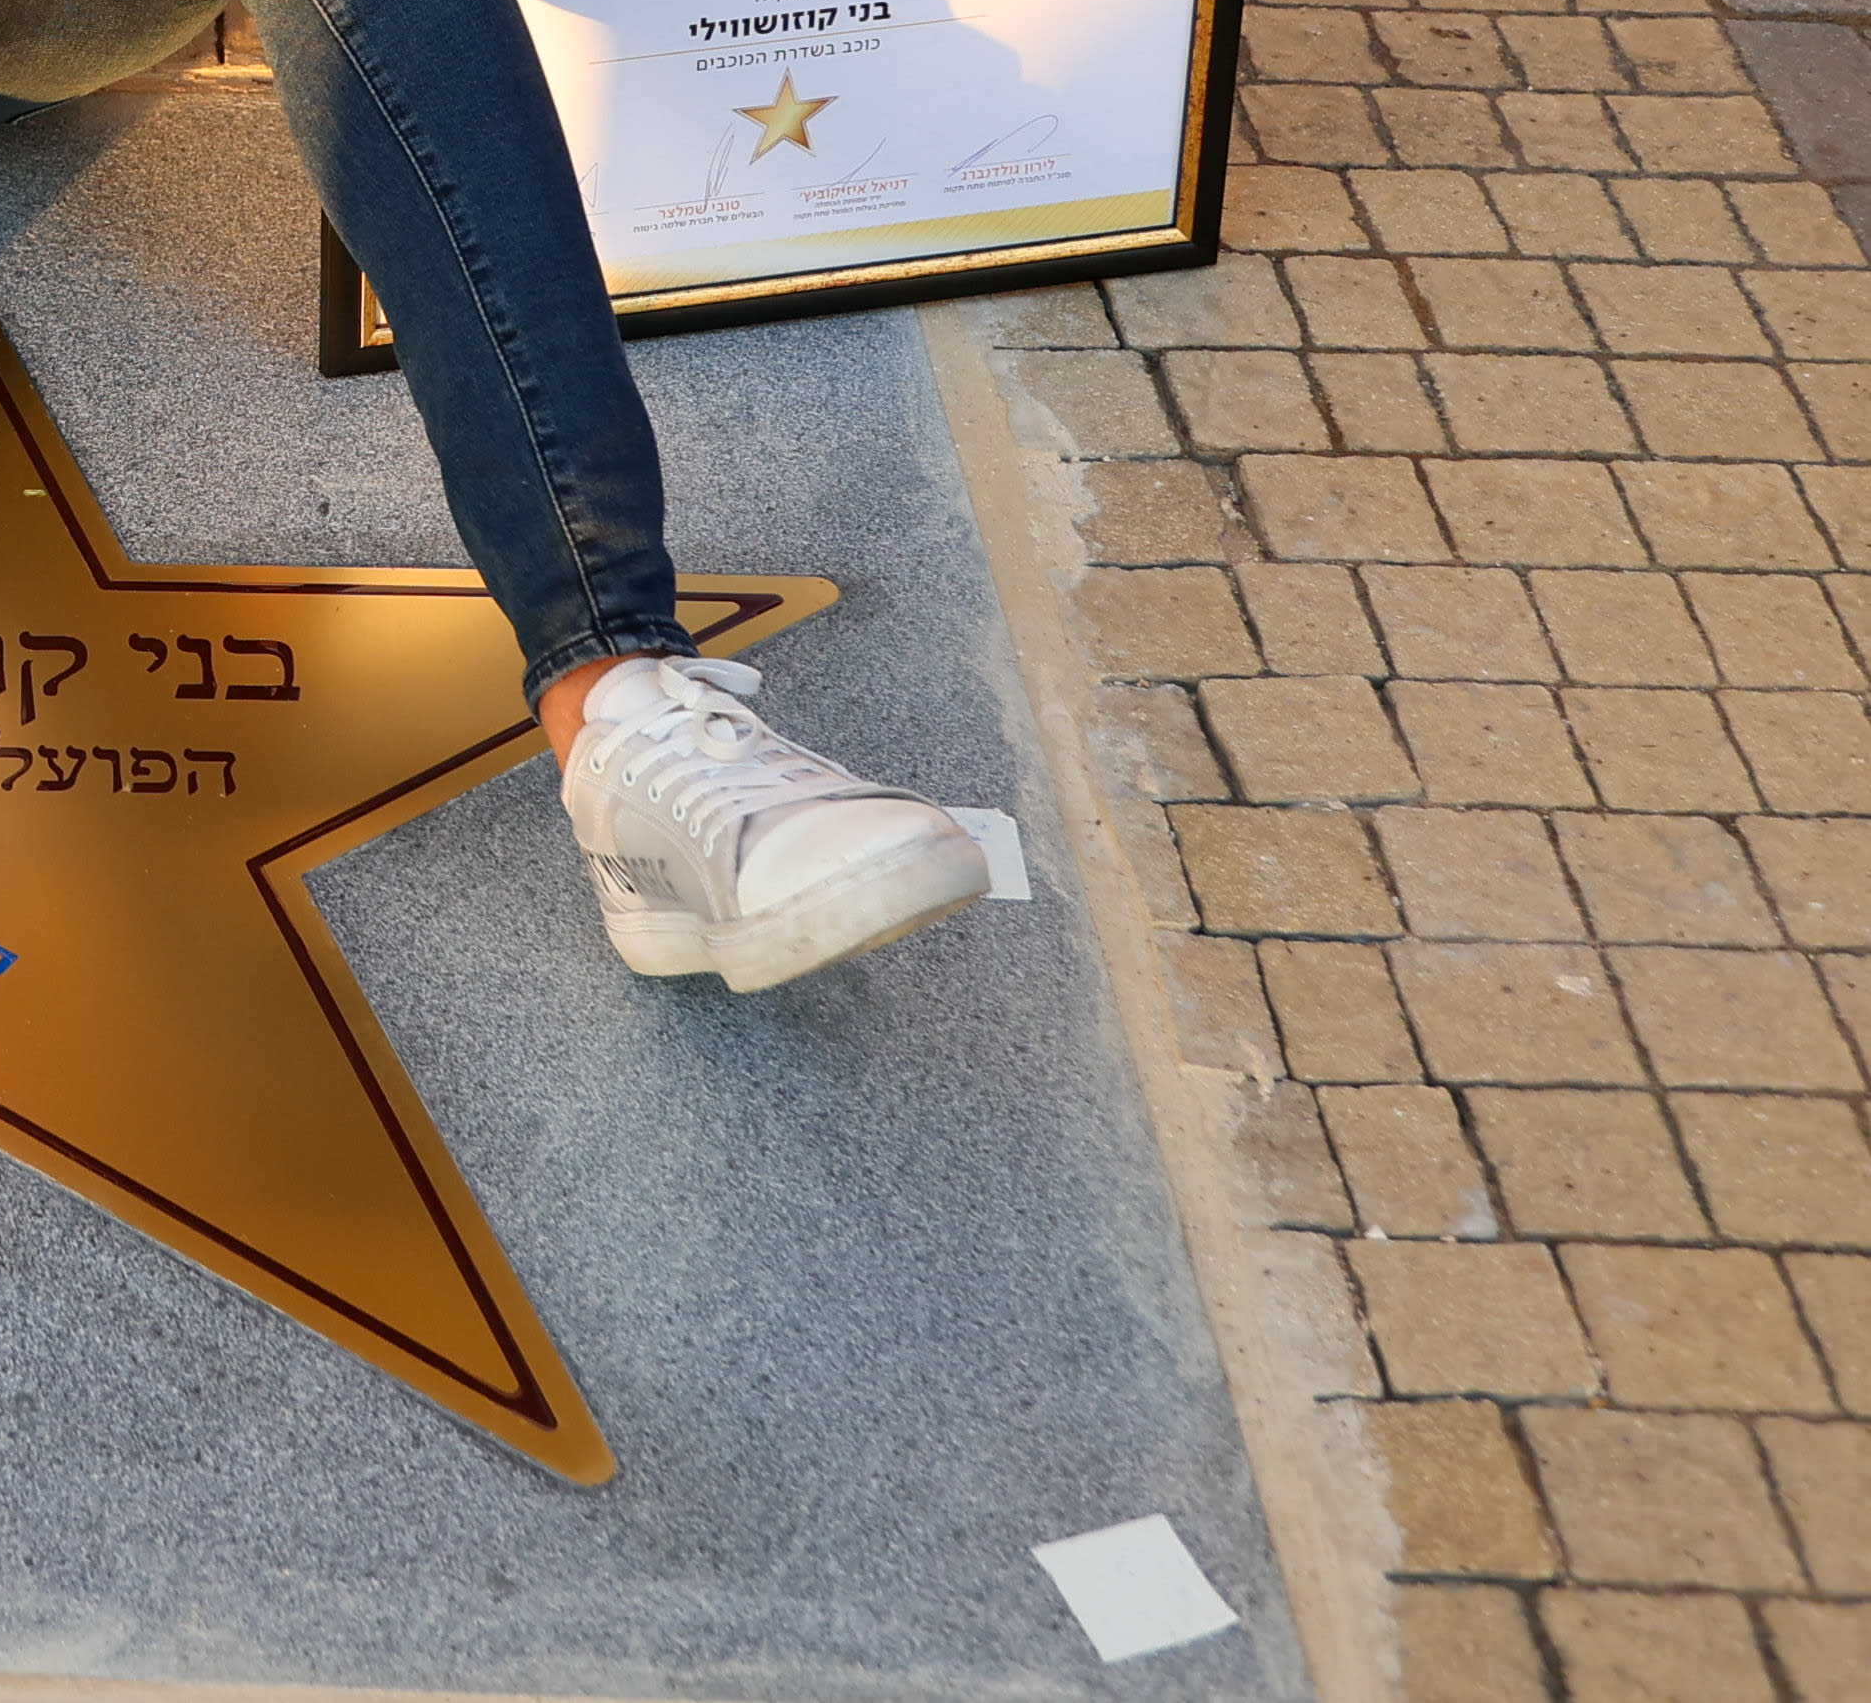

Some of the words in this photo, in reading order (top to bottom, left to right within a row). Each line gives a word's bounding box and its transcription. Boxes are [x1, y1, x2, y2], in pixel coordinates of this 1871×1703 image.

[848, 1, 892, 23] בני
[688, 6, 839, 41] קוזושווילי
[773, 44, 836, 63] בשדרת
[842, 38, 881, 54] כוכב
[696, 52, 768, 72] הכוכבים
[960, 164, 1020, 181] גולדנברג
[1024, 158, 1056, 175] לירון
[871, 178, 909, 193] דניאל
[658, 204, 708, 220] שמלצר
[712, 199, 741, 213] טובי
[128, 630, 301, 701] בני
